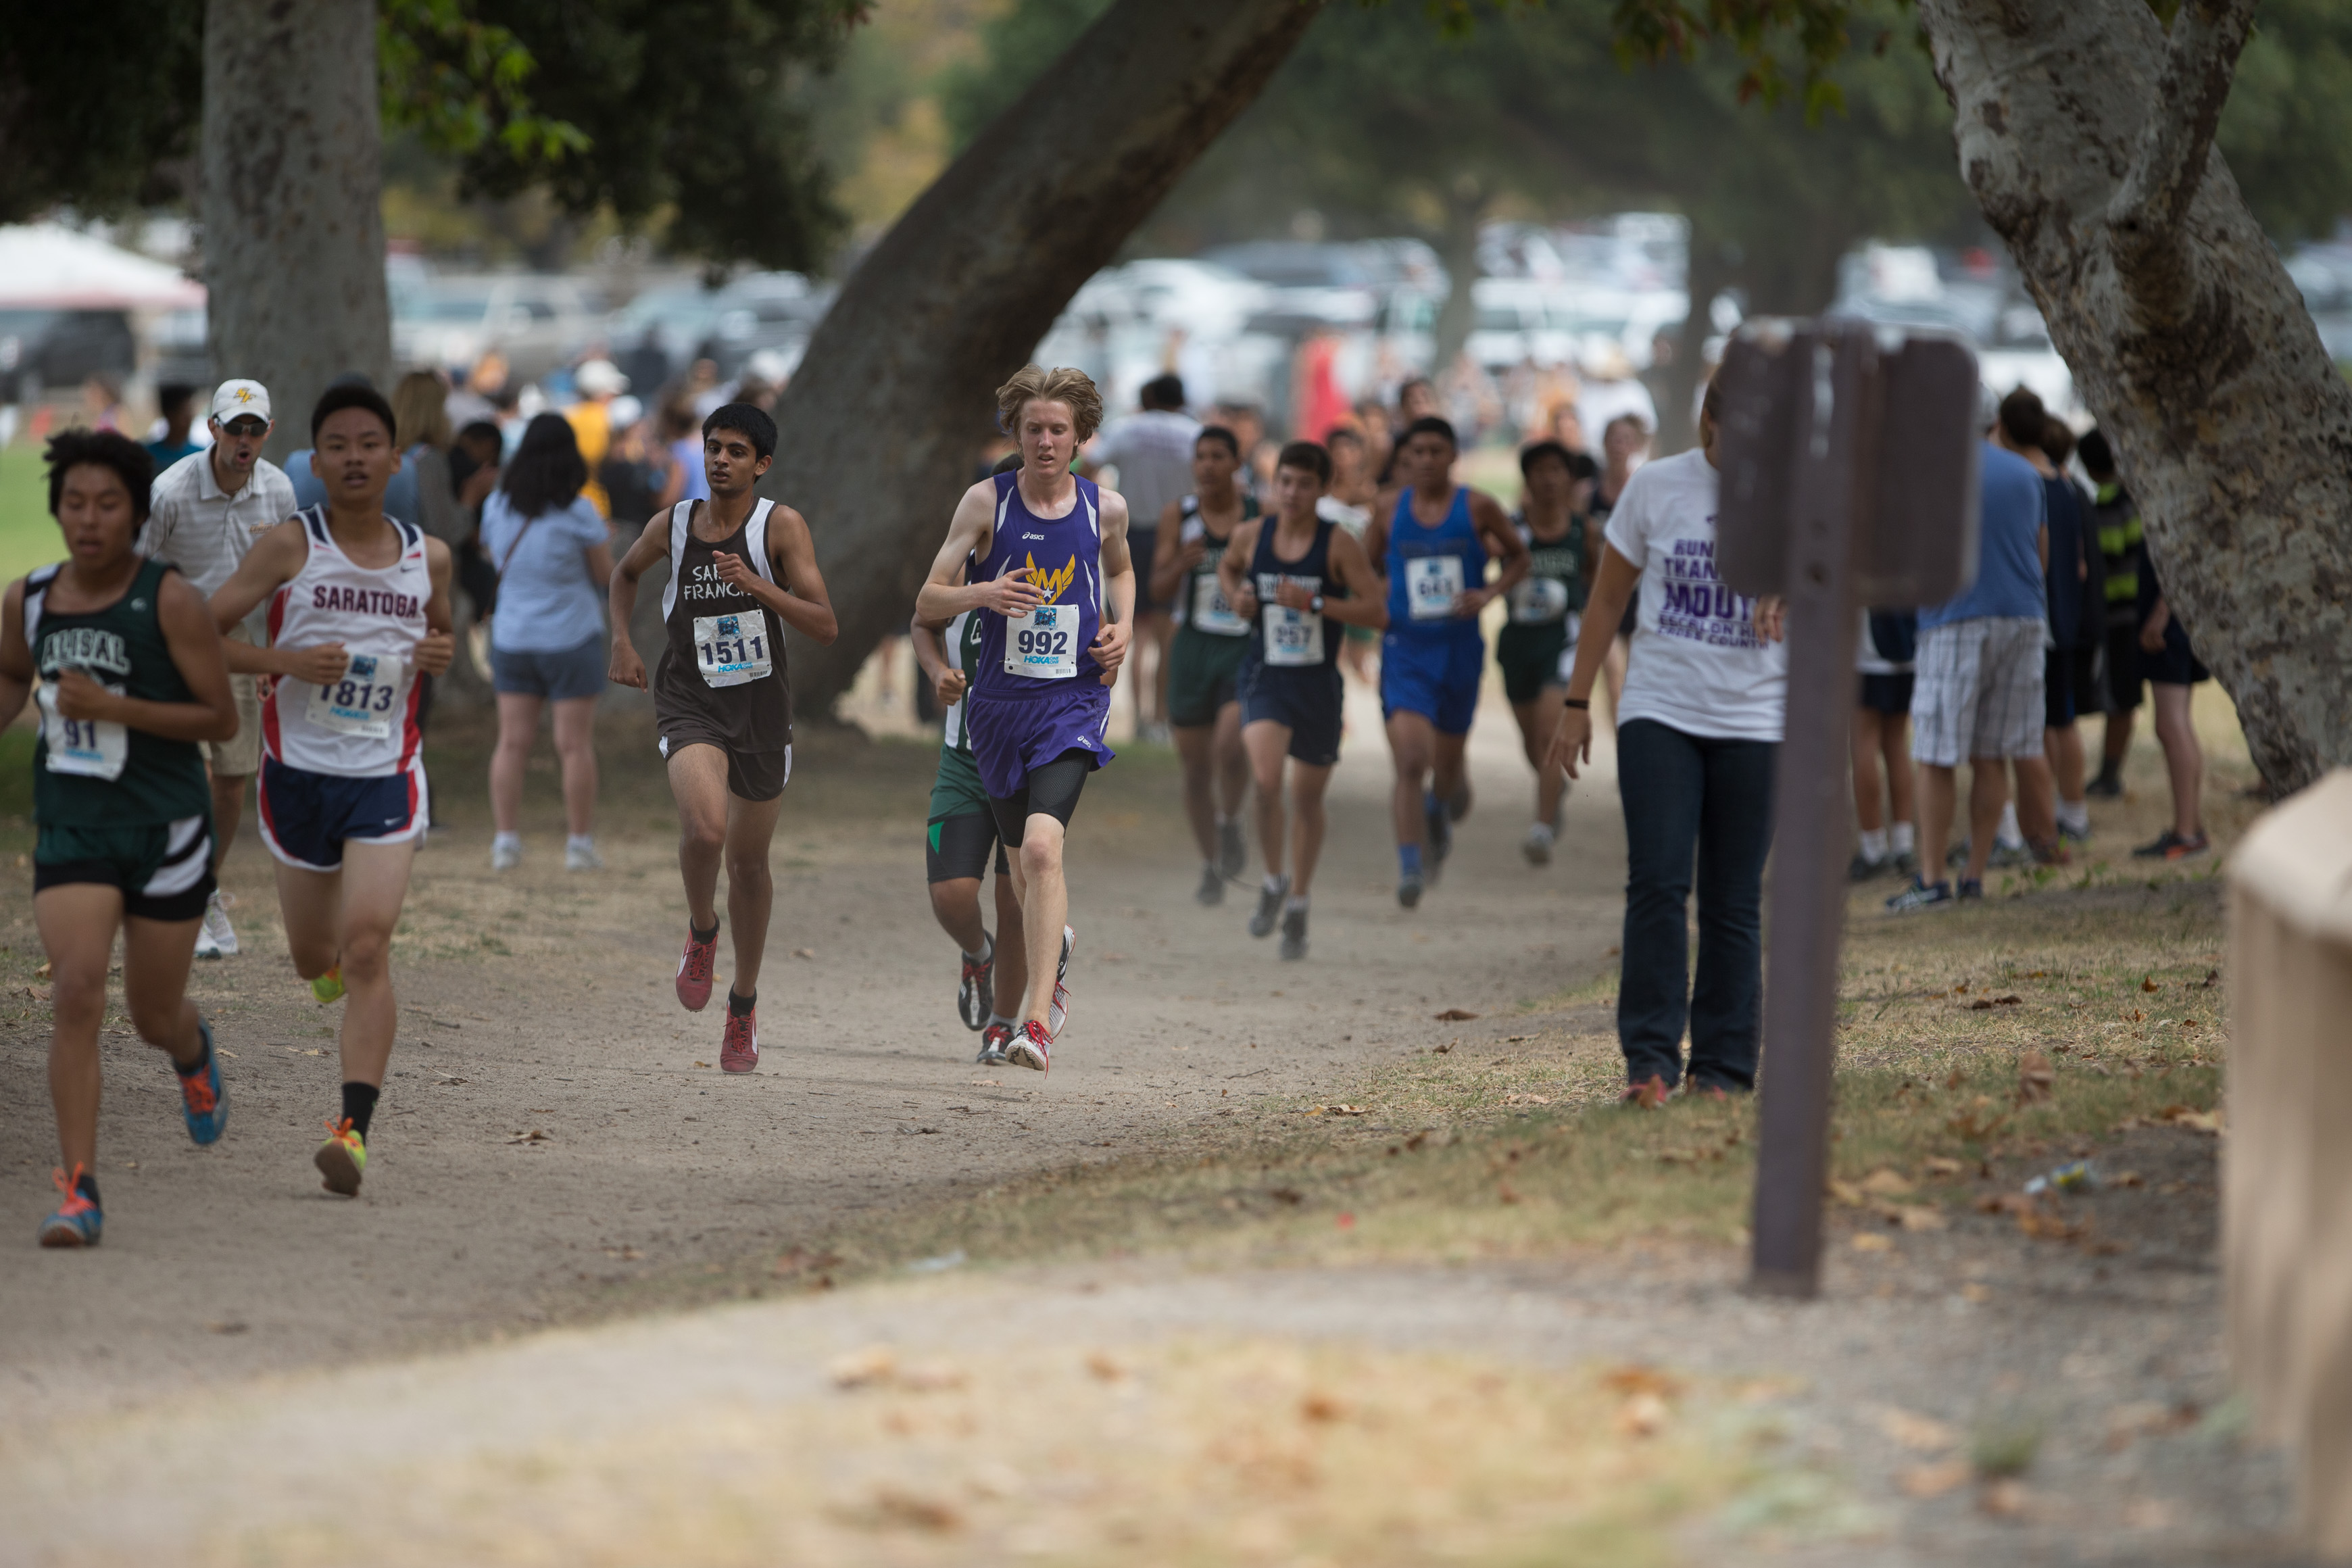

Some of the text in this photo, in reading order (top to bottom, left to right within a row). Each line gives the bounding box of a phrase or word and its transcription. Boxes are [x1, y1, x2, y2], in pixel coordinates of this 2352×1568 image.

[692, 563, 722, 582] SAI
[312, 585, 418, 618] SARATOGA
[684, 581, 752, 600] FRANC
[1663, 581, 1752, 621] MOUT
[41, 628, 132, 676] ALISAL
[700, 635, 764, 666] 1511
[1018, 630, 1068, 656] 992
[718, 664, 743, 673] HOKA
[1023, 655, 1050, 664] HOKA
[320, 679, 394, 712] 1813
